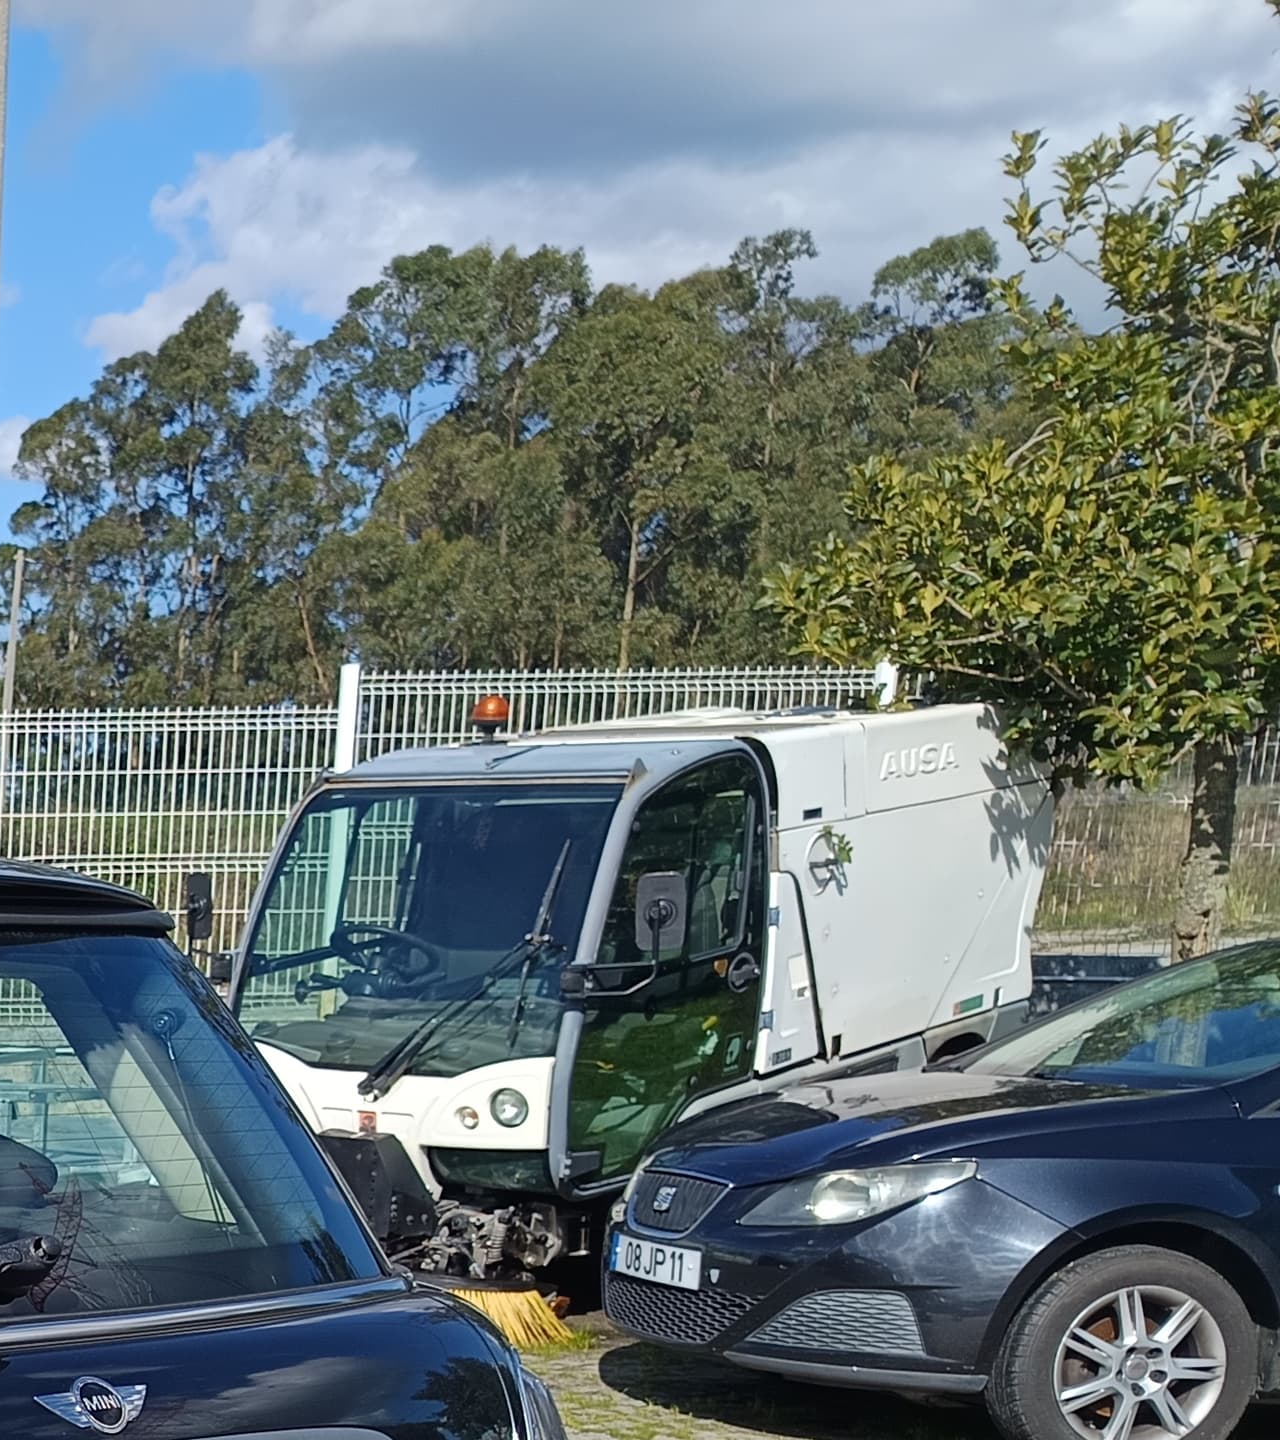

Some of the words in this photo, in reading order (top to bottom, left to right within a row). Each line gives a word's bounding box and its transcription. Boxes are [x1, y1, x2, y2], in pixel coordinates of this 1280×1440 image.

[880, 742, 959, 782] AUSA
[625, 1241, 642, 1272] 08
[643, 1246, 666, 1277] JP
[670, 1250, 684, 1282] 11
[82, 1394, 121, 1412] MINI
